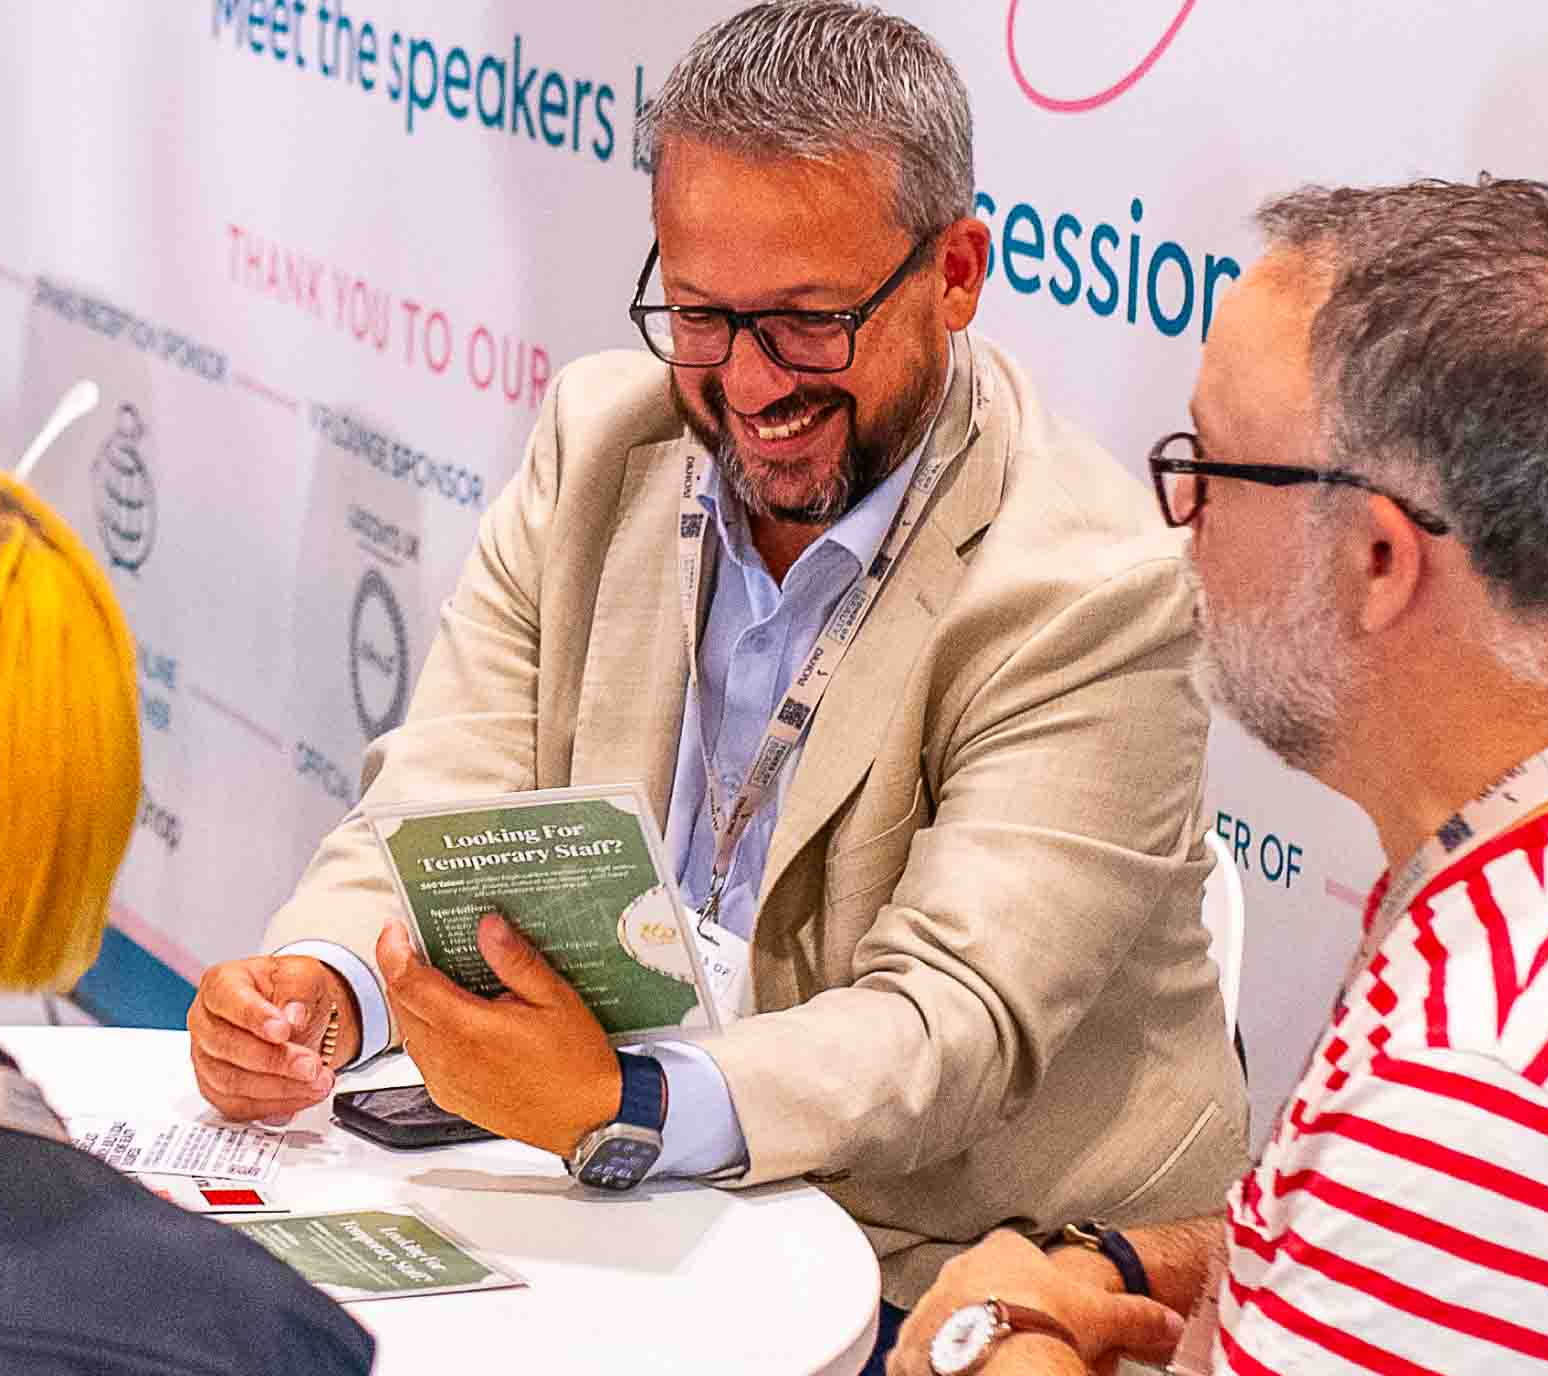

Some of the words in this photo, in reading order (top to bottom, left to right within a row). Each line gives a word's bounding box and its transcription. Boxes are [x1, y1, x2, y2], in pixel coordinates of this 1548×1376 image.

[387, 33, 616, 162] speakers
[229, 222, 324, 318] THANK
[332, 265, 390, 352] YOU
[401, 298, 452, 373] TO
[467, 320, 551, 409] OUR
[417, 847, 550, 873] Temporary
[554, 839, 624, 860] Staff?
[442, 827, 541, 850] Looking
[542, 823, 585, 840] For
[1260, 833, 1303, 889] OF
